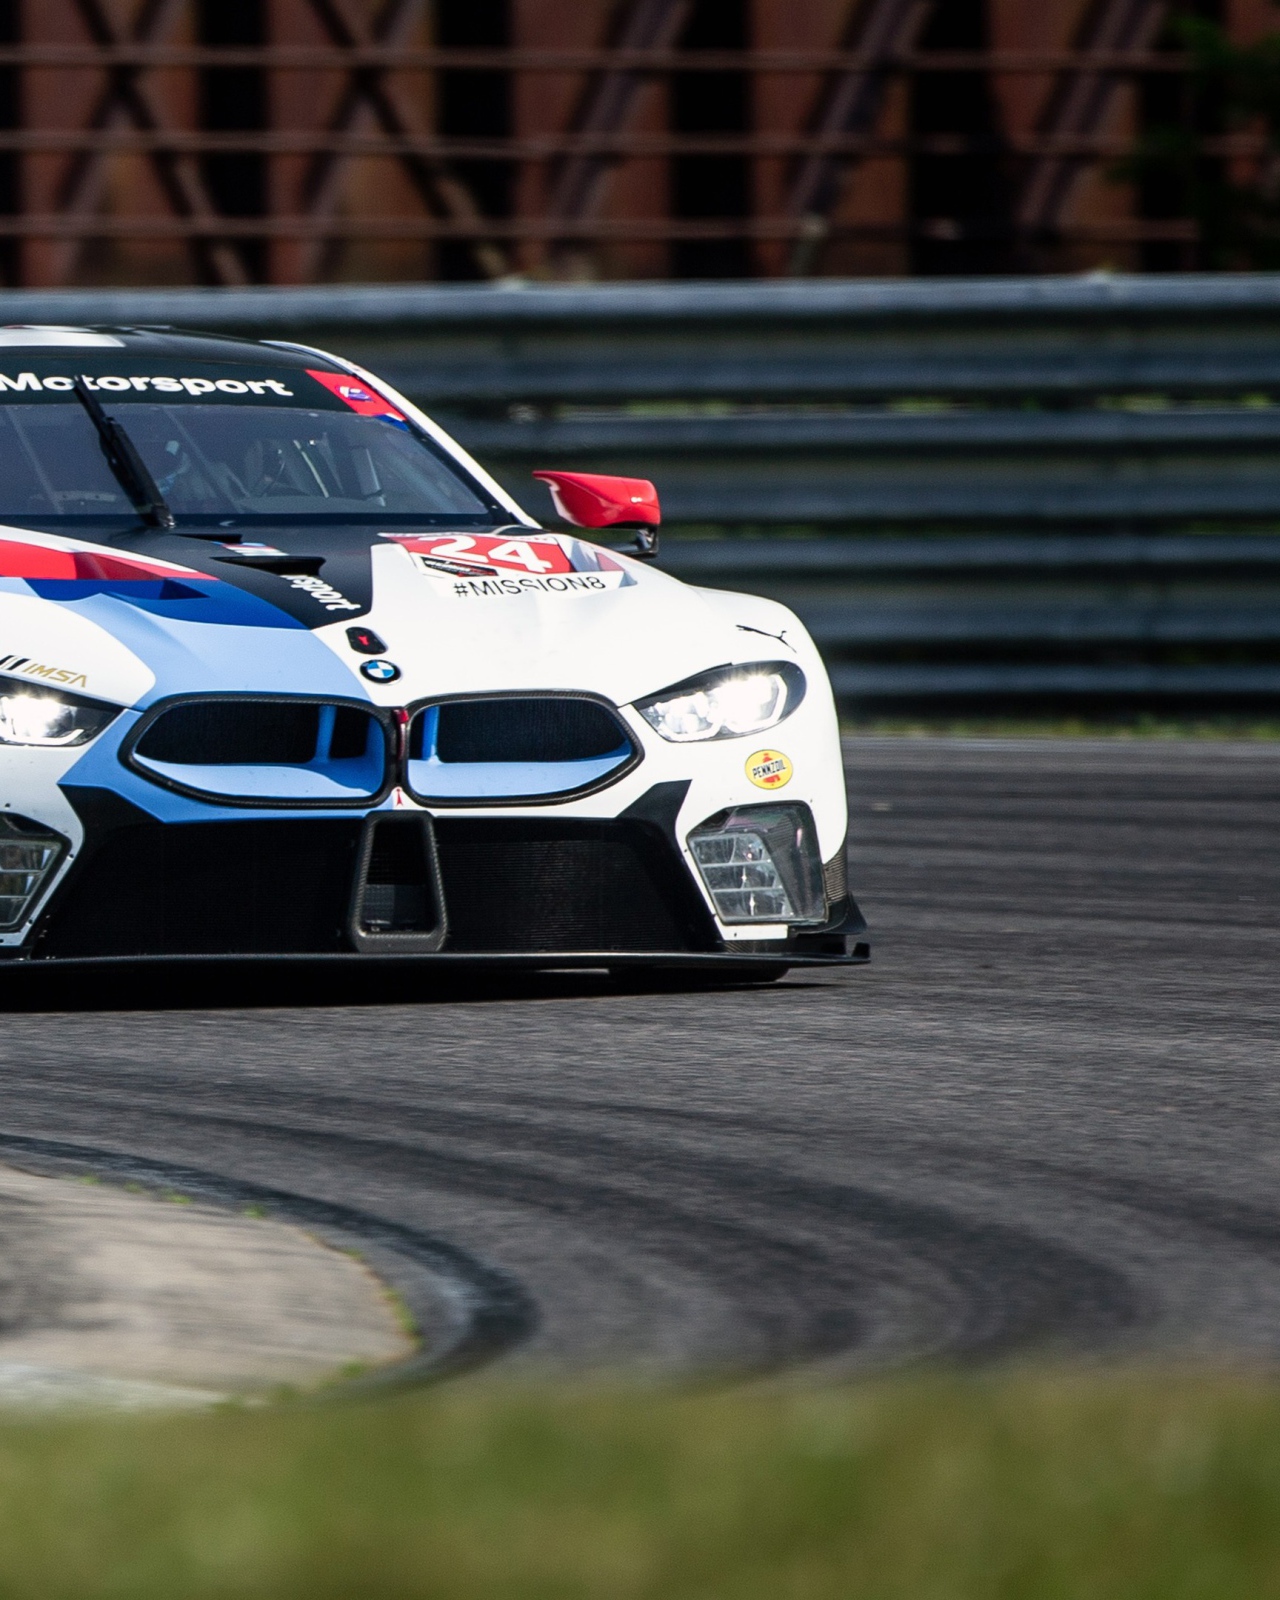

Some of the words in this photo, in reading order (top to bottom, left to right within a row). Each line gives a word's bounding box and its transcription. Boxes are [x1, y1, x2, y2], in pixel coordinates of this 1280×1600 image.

[417, 535, 553, 573] 24
[452, 576, 607, 598] #MISSION8
[22, 663, 87, 688] IMSA
